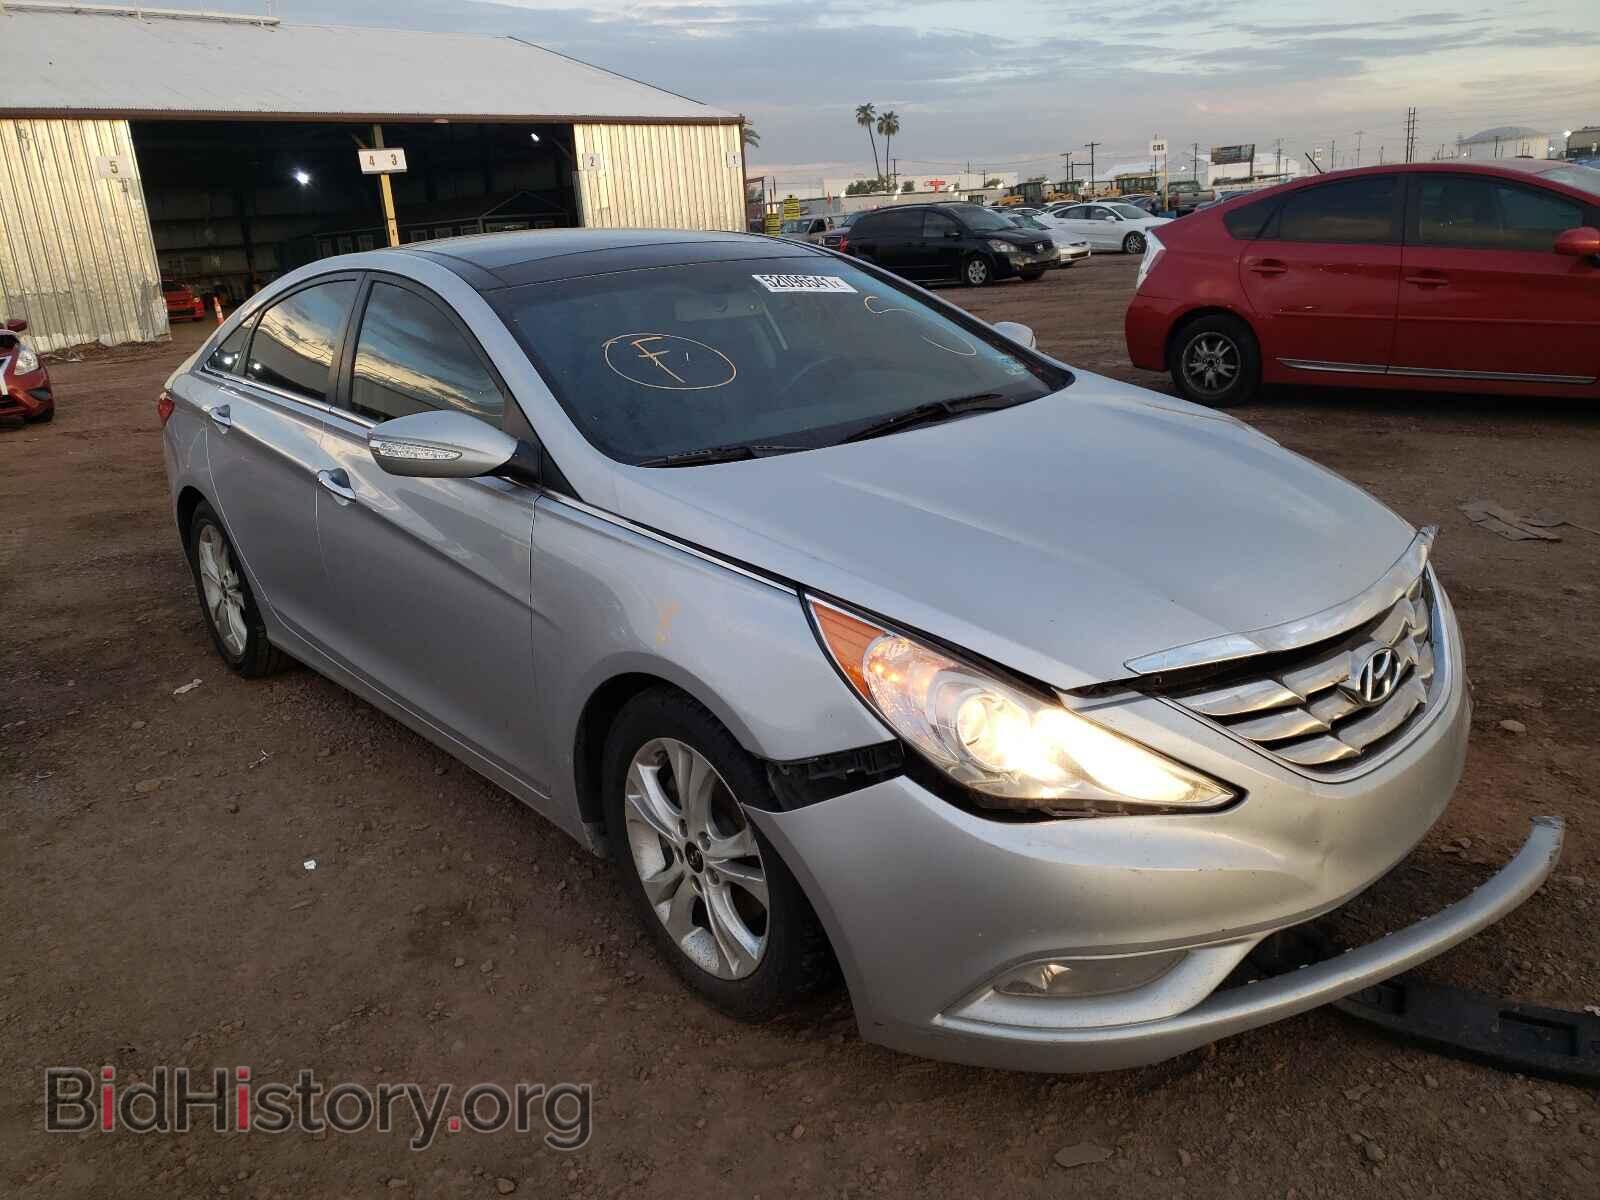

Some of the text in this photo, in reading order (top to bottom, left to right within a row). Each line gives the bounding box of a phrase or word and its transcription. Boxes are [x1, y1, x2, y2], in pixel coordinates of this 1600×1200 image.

[369, 153, 397, 166] 4 3
[590, 156, 596, 167] 2
[109, 160, 118, 174] 5
[630, 336, 686, 383] F
